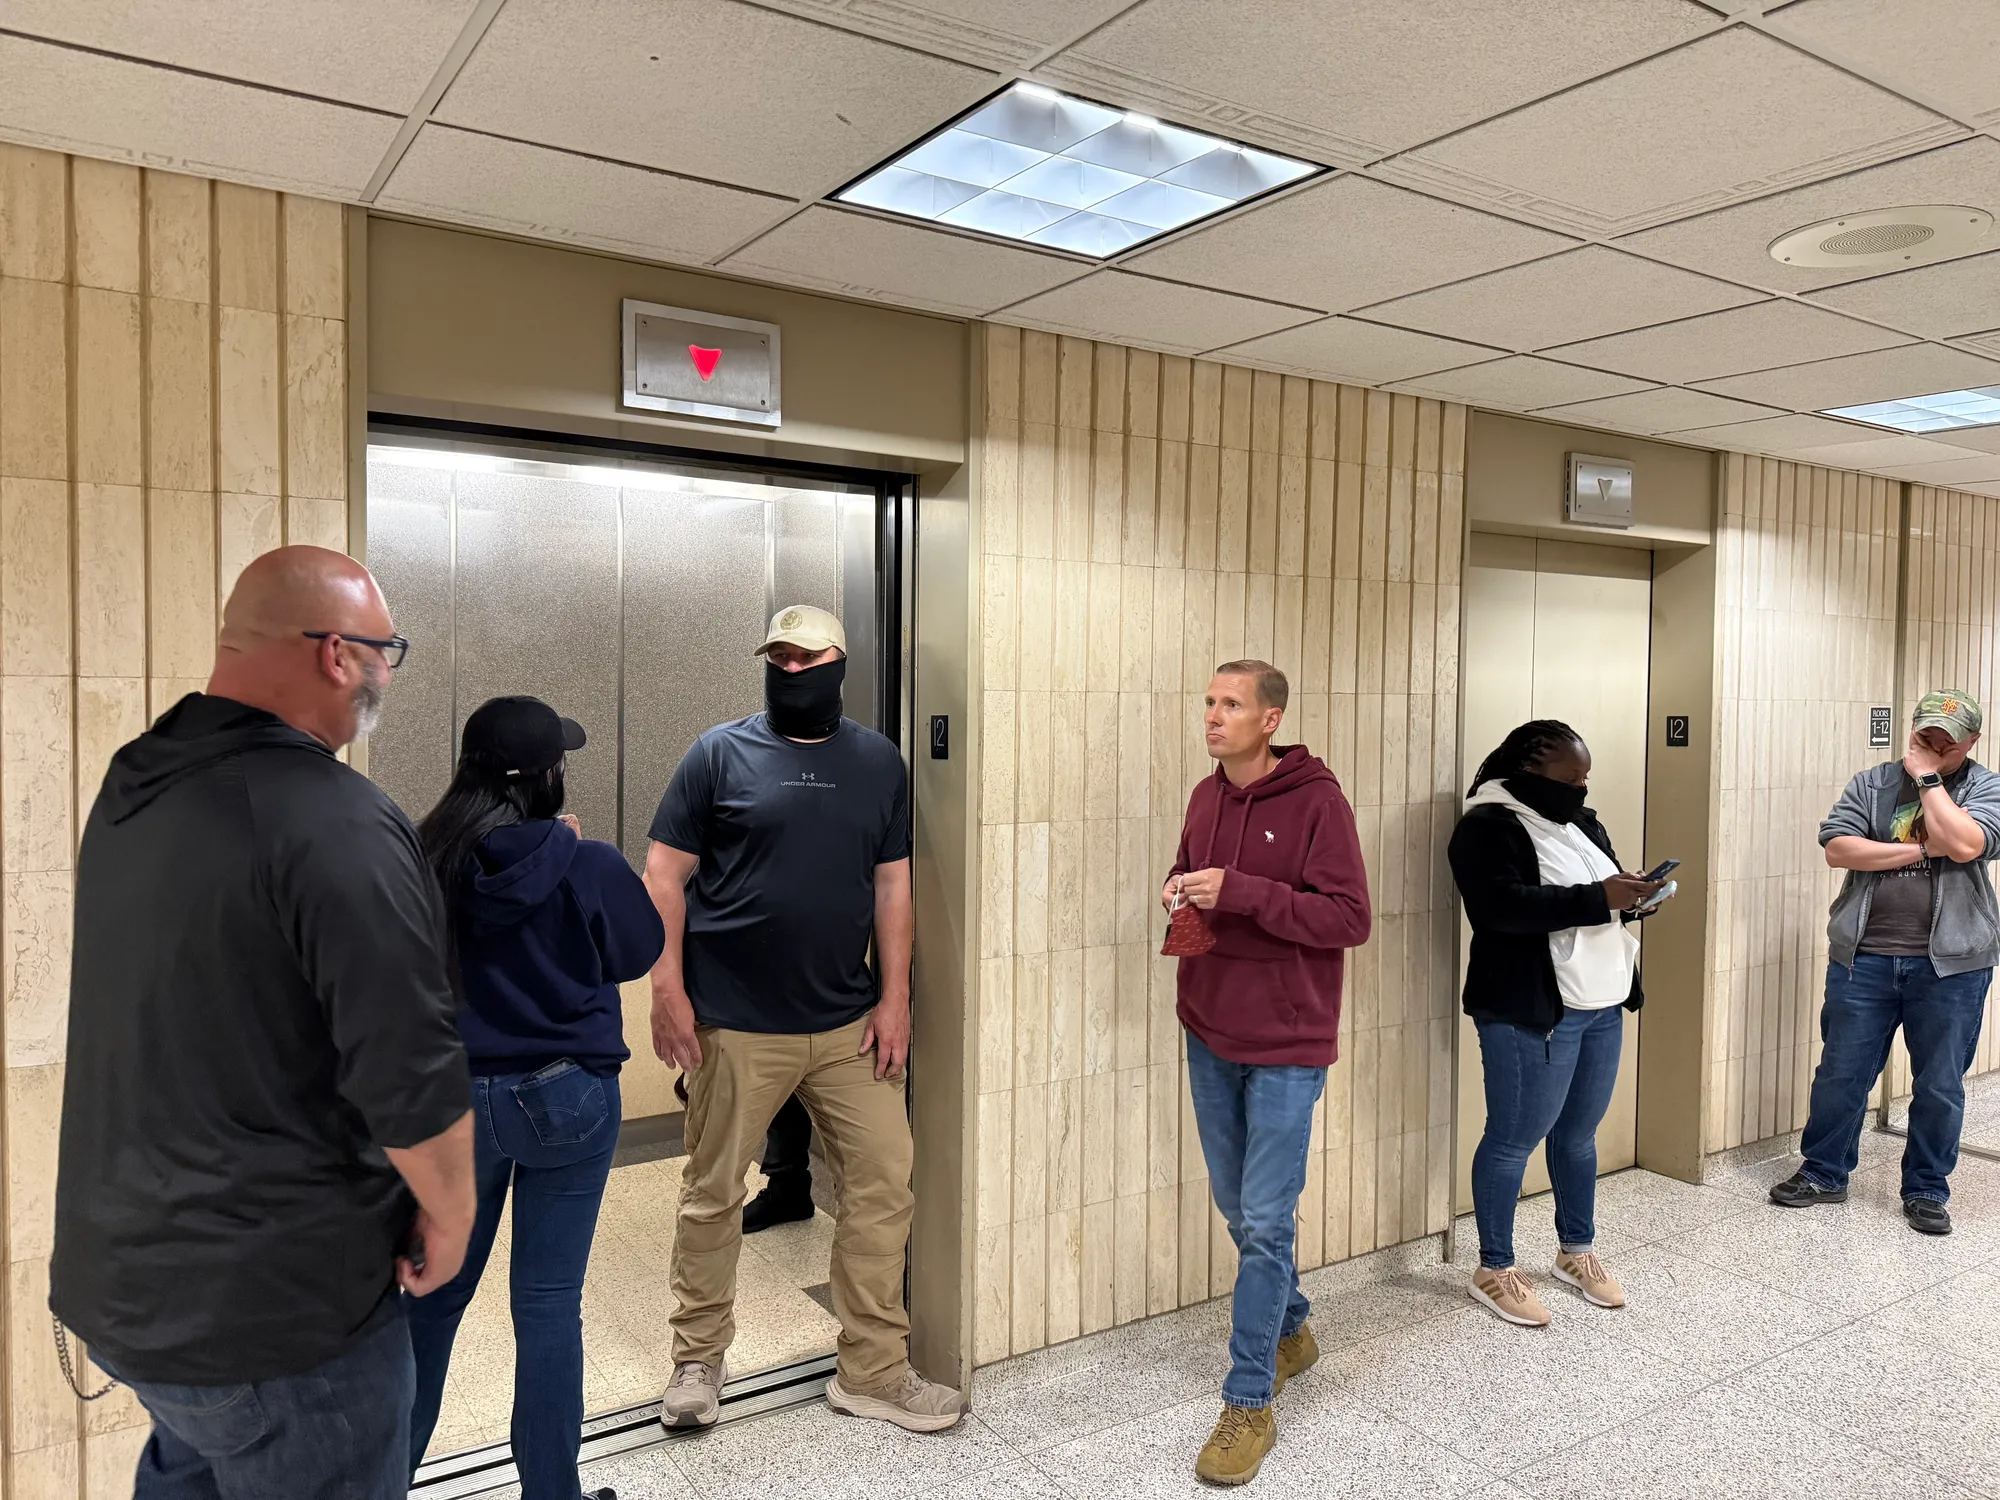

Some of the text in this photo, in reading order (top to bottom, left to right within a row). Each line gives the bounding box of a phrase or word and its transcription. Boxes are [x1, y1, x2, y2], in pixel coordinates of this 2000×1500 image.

[933, 718, 945, 747] 12
[1670, 719, 1684, 739] 12
[1871, 720, 1889, 735] 1-12
[1898, 870, 1917, 878] RUN
[588, 1406, 661, 1432] STINGH
